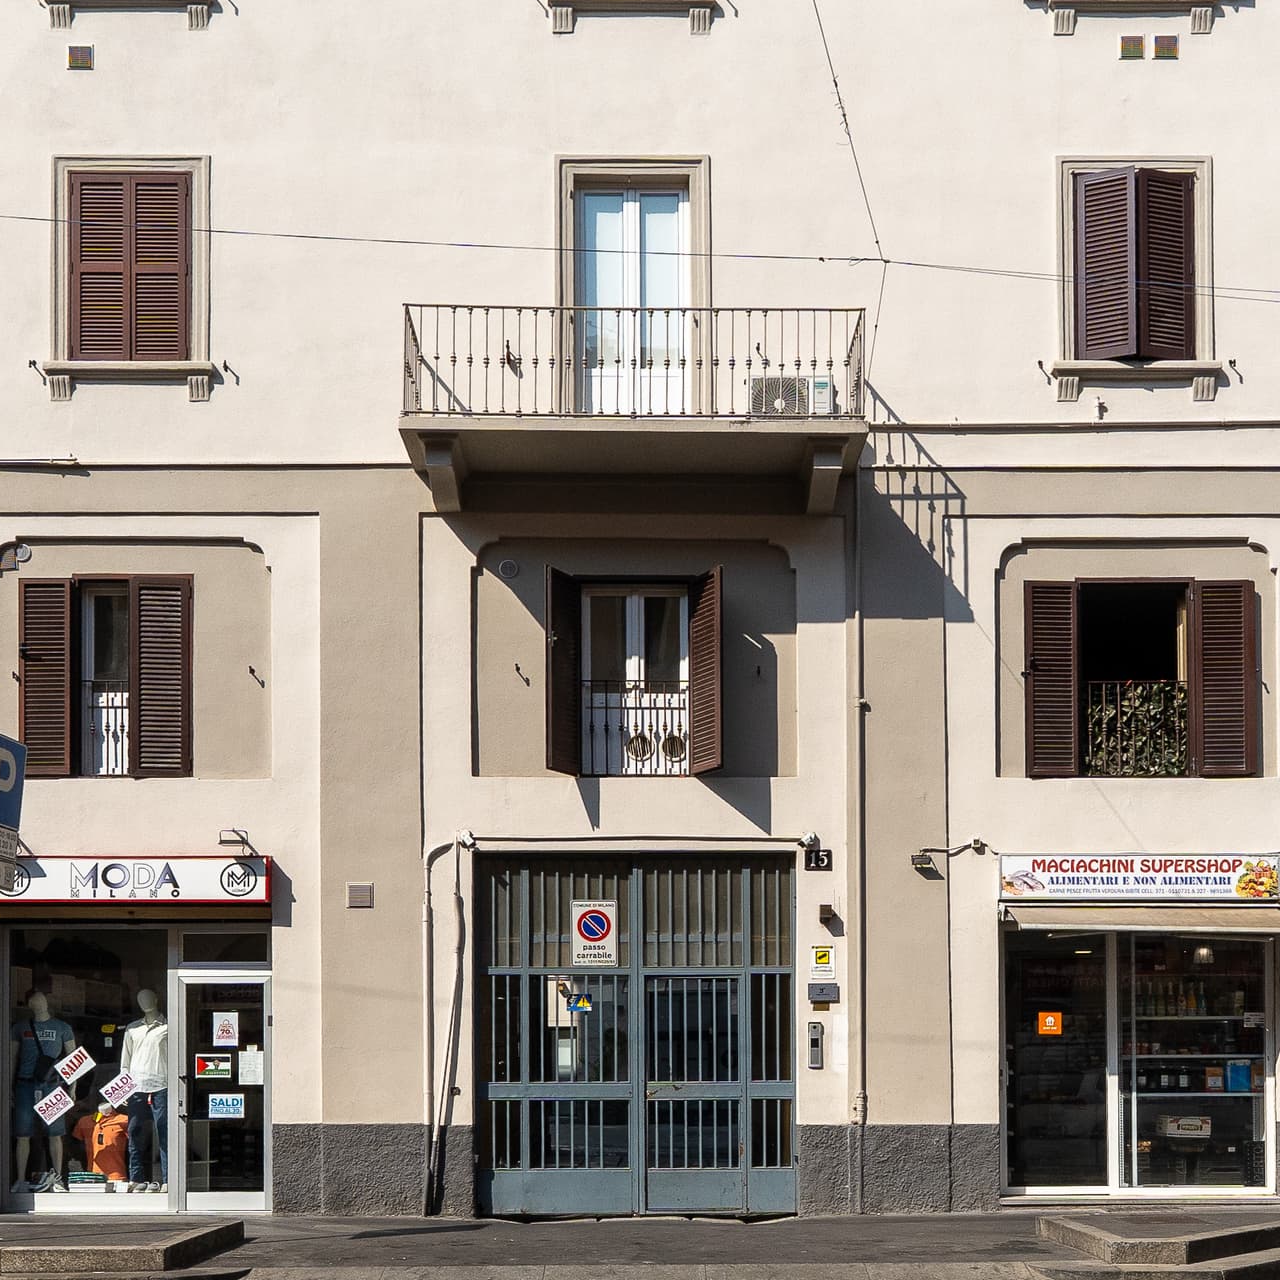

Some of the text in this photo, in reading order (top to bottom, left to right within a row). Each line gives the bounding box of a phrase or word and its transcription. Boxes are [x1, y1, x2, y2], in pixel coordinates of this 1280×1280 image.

[810, 851, 828, 867] 15
[1032, 859, 1243, 873] MACIACHINI SUPERSHOP
[71, 863, 180, 888] MODA
[1048, 876, 1231, 885] ALIMENTARI E NON ALIMENTARI
[71, 890, 180, 898] MILANO
[60, 1050, 88, 1079] SALDI
[104, 1073, 132, 1098] SALDI
[38, 1090, 66, 1115] SALDI
[210, 1098, 243, 1107] SALDI
